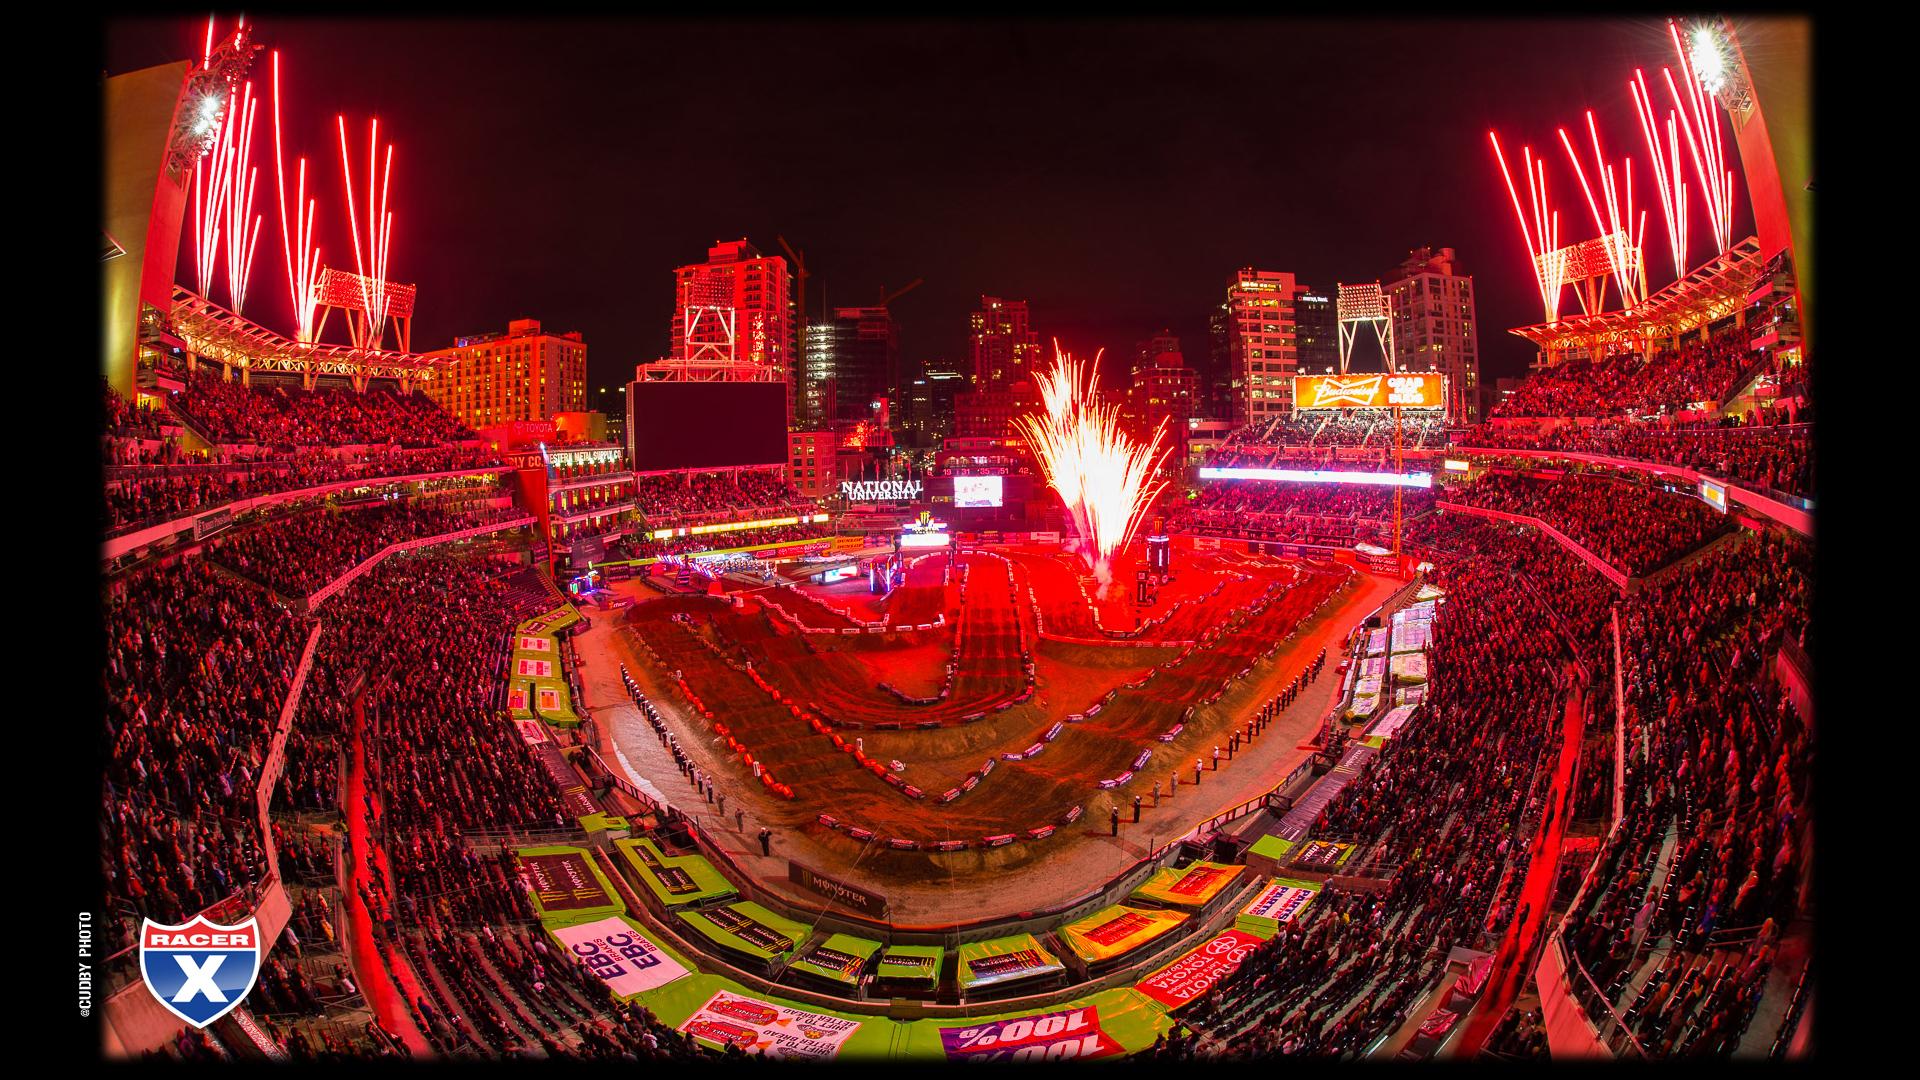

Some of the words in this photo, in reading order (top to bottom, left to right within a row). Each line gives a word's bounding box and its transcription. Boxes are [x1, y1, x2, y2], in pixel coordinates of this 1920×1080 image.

[526, 423, 553, 433] TOYOTA
[528, 456, 544, 467] CO.
[574, 451, 592, 462] METAL
[1018, 467, 1029, 475] 42
[841, 479, 924, 493] NATIONAL
[848, 490, 918, 501] UNIVERSITY
[529, 862, 551, 892] MONSTER
[561, 859, 584, 889] MONSTER
[813, 876, 868, 906] MONSTER
[1257, 886, 1289, 916] PARTS
[1277, 889, 1312, 921] PARTS
[593, 938, 624, 962] BRAKES
[606, 933, 662, 970] EBC
[626, 930, 657, 952] BRAKES
[572, 941, 628, 980] EBC
[1152, 956, 1215, 989] TOYOTA
[782, 1008, 817, 1020] BREAD
[803, 1018, 816, 1026] TO
[762, 1029, 797, 1042] BREAD
[959, 1010, 1090, 1049] 100%
[785, 1038, 799, 1048] TO
